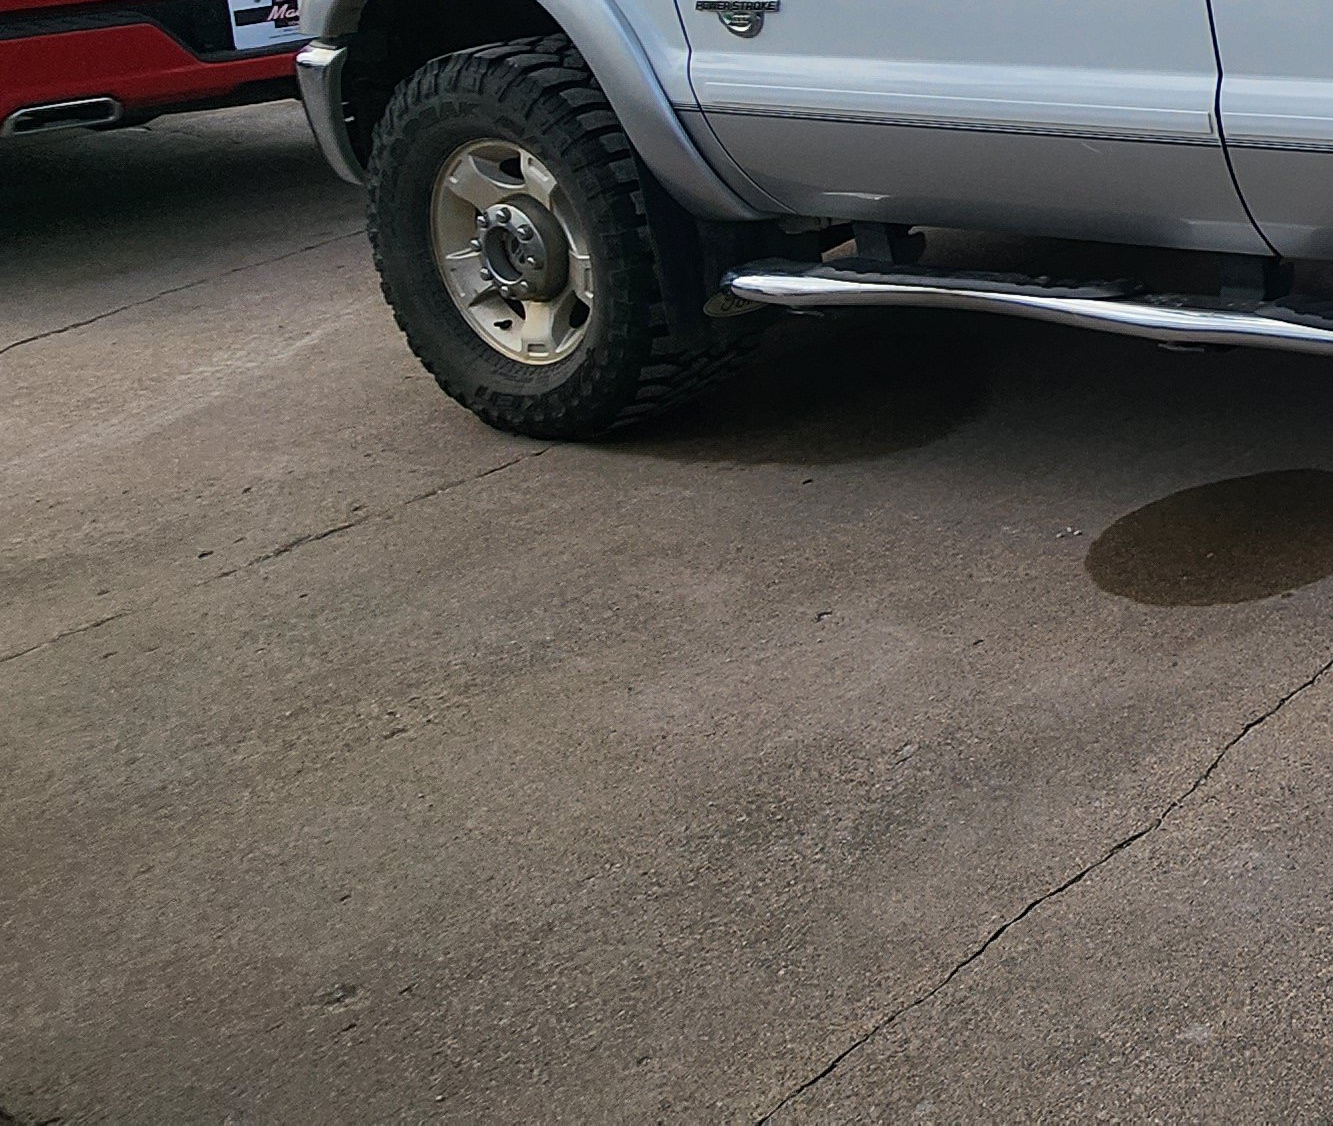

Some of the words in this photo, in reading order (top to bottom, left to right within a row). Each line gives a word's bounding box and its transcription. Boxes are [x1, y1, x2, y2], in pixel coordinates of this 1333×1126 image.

[267, 3, 300, 21] Ma
[695, 0, 731, 11] POWER
[732, 0, 776, 11] STROKE
